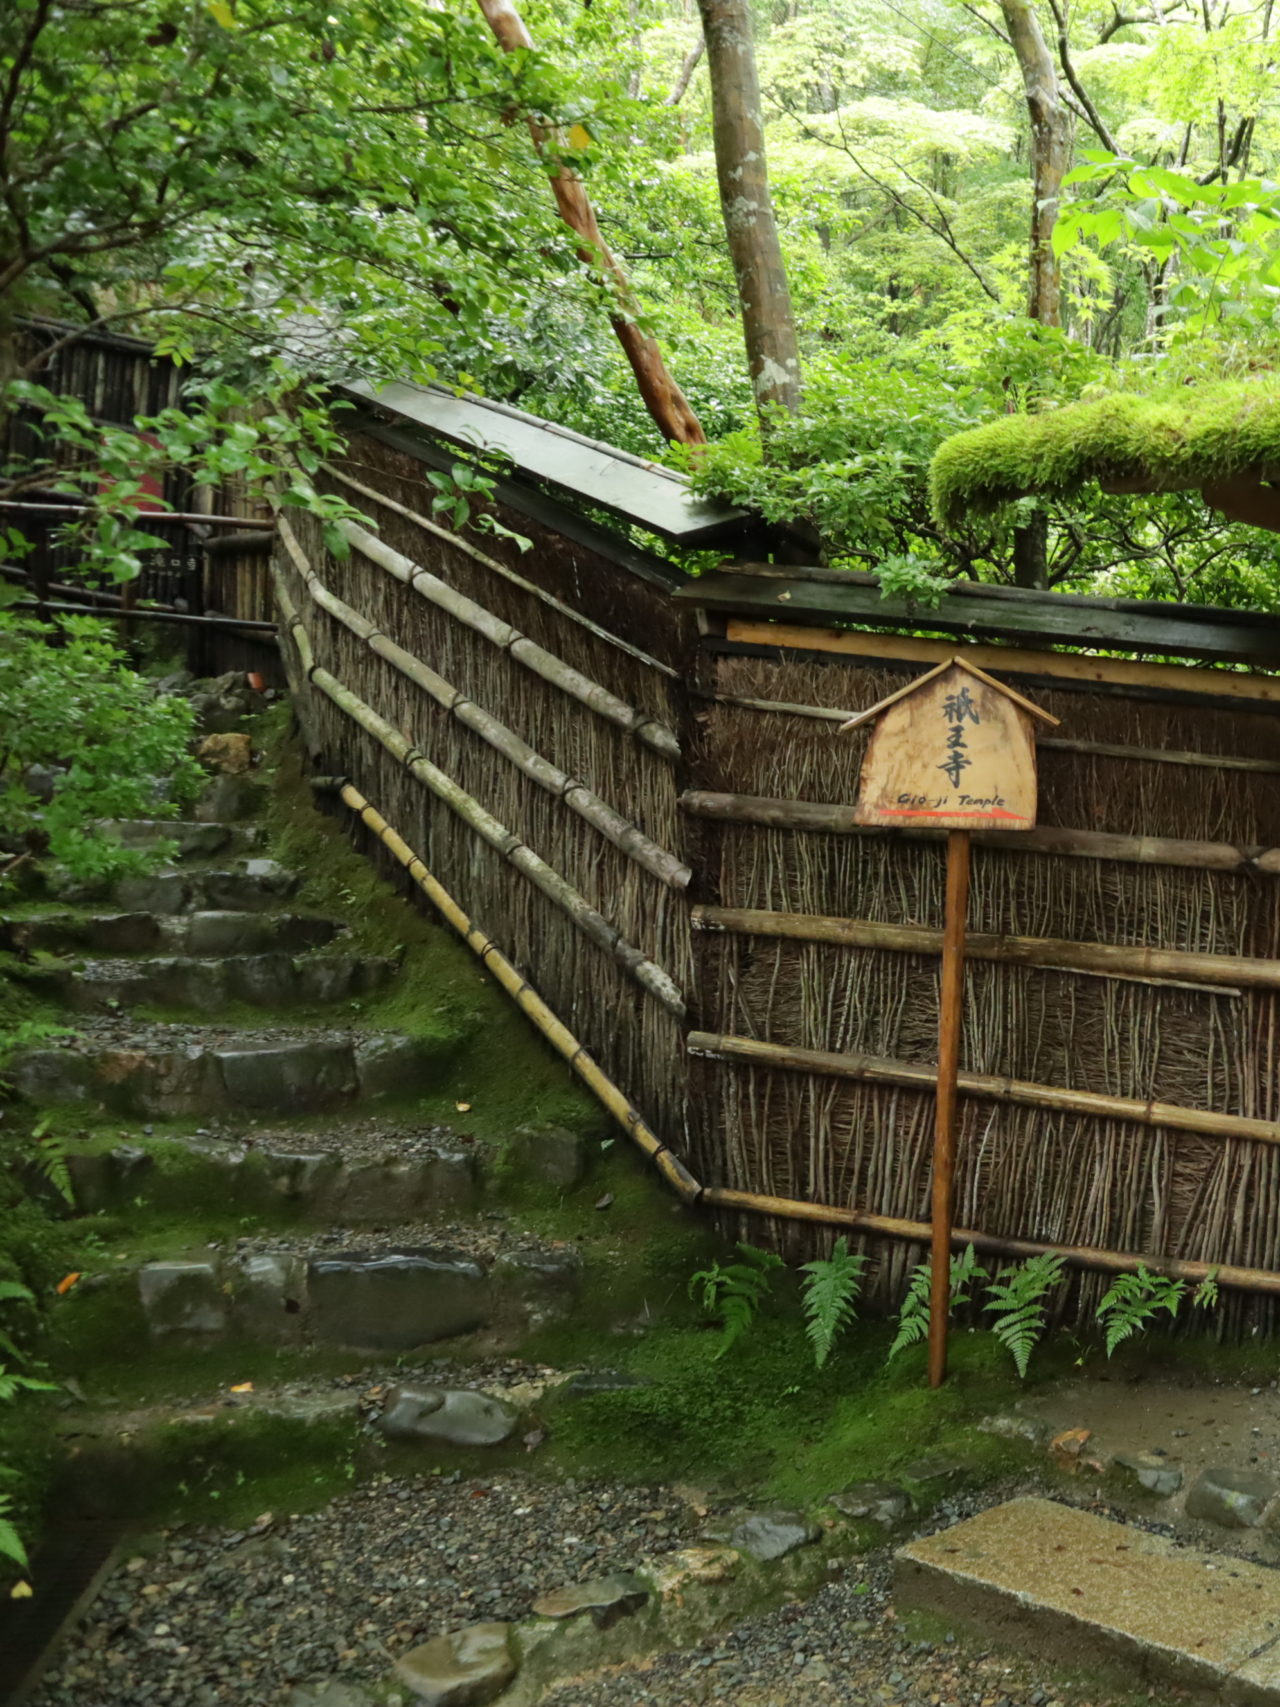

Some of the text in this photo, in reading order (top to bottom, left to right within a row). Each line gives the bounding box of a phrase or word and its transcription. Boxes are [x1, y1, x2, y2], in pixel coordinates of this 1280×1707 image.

[937, 687, 980, 789] 祇王寺
[958, 795, 1005, 808] Temple
